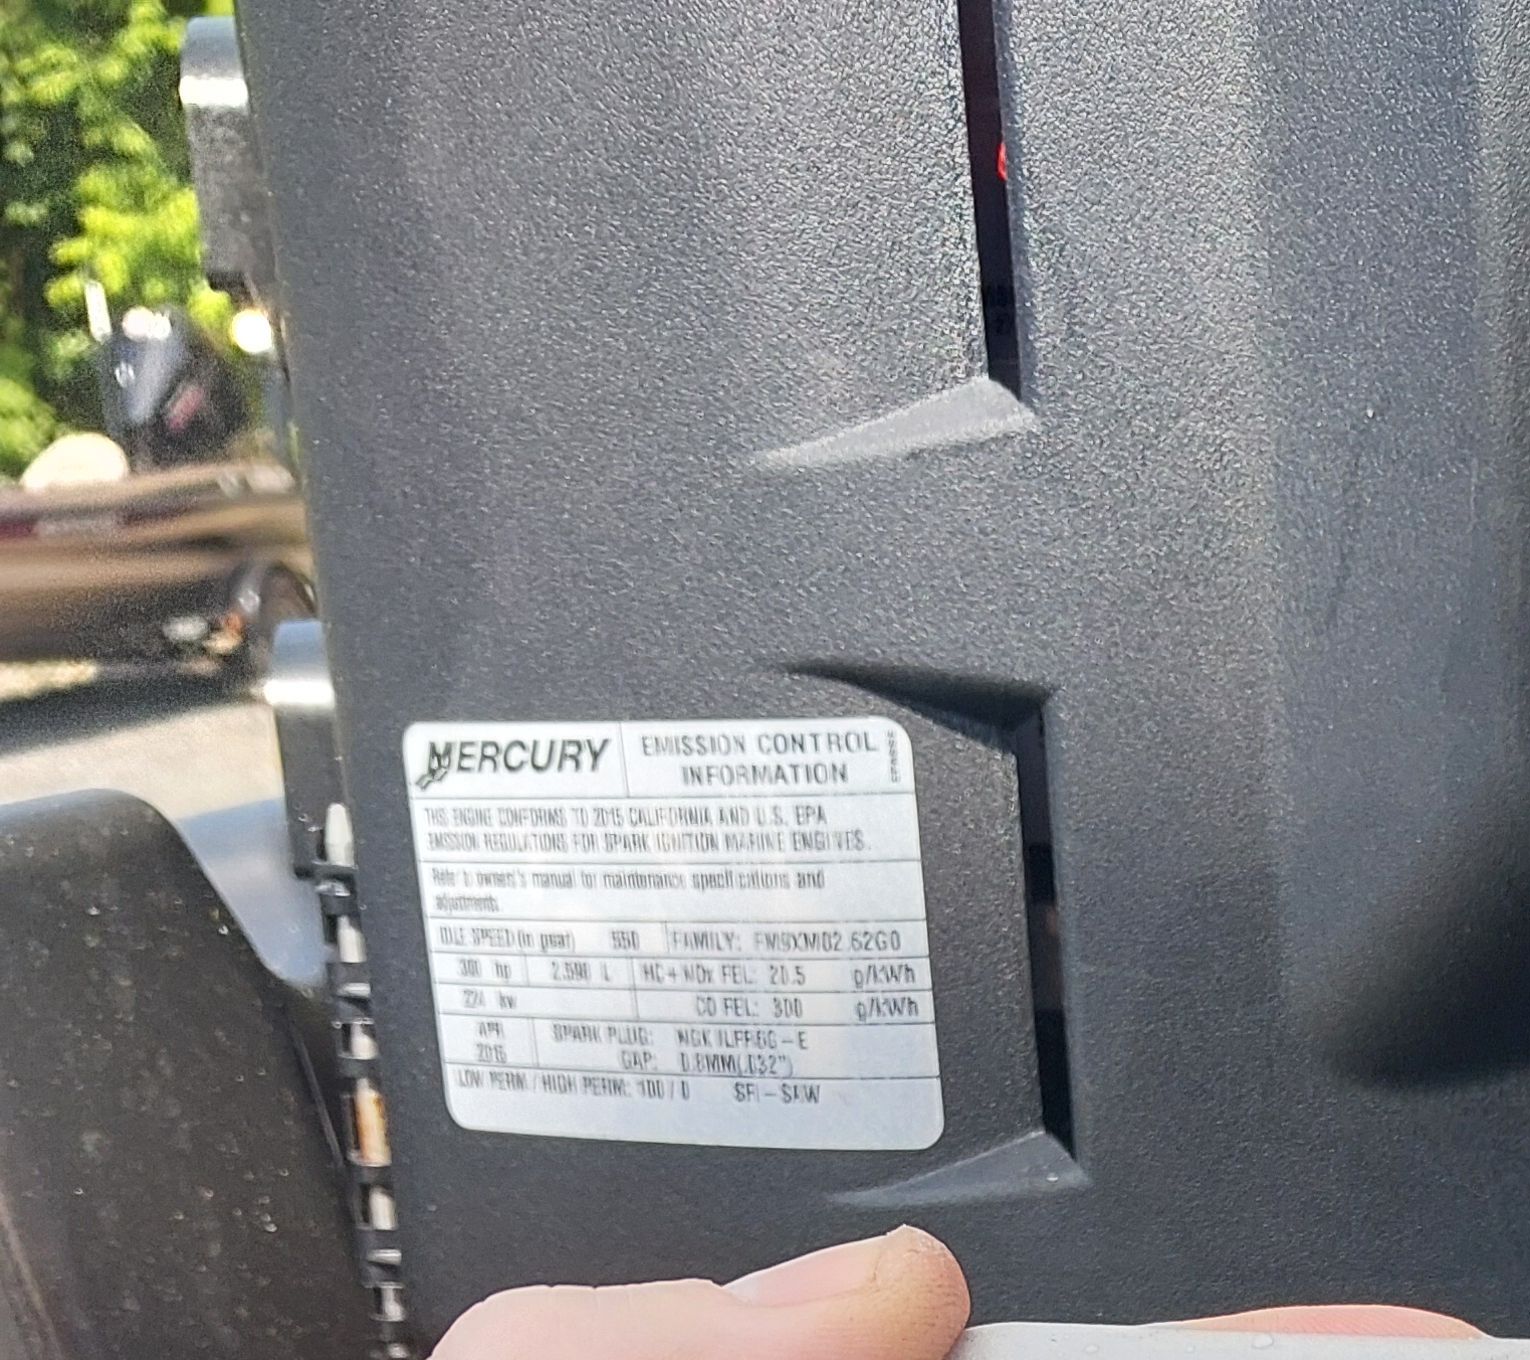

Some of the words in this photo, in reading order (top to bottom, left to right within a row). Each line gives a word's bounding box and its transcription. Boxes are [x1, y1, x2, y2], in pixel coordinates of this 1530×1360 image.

[426, 738, 612, 774] MERCURY
[641, 734, 746, 757] EMISSION
[757, 731, 880, 755] CONTROL
[681, 762, 849, 787] INFORMATION
[719, 805, 750, 827] AND
[795, 803, 829, 826] EPA
